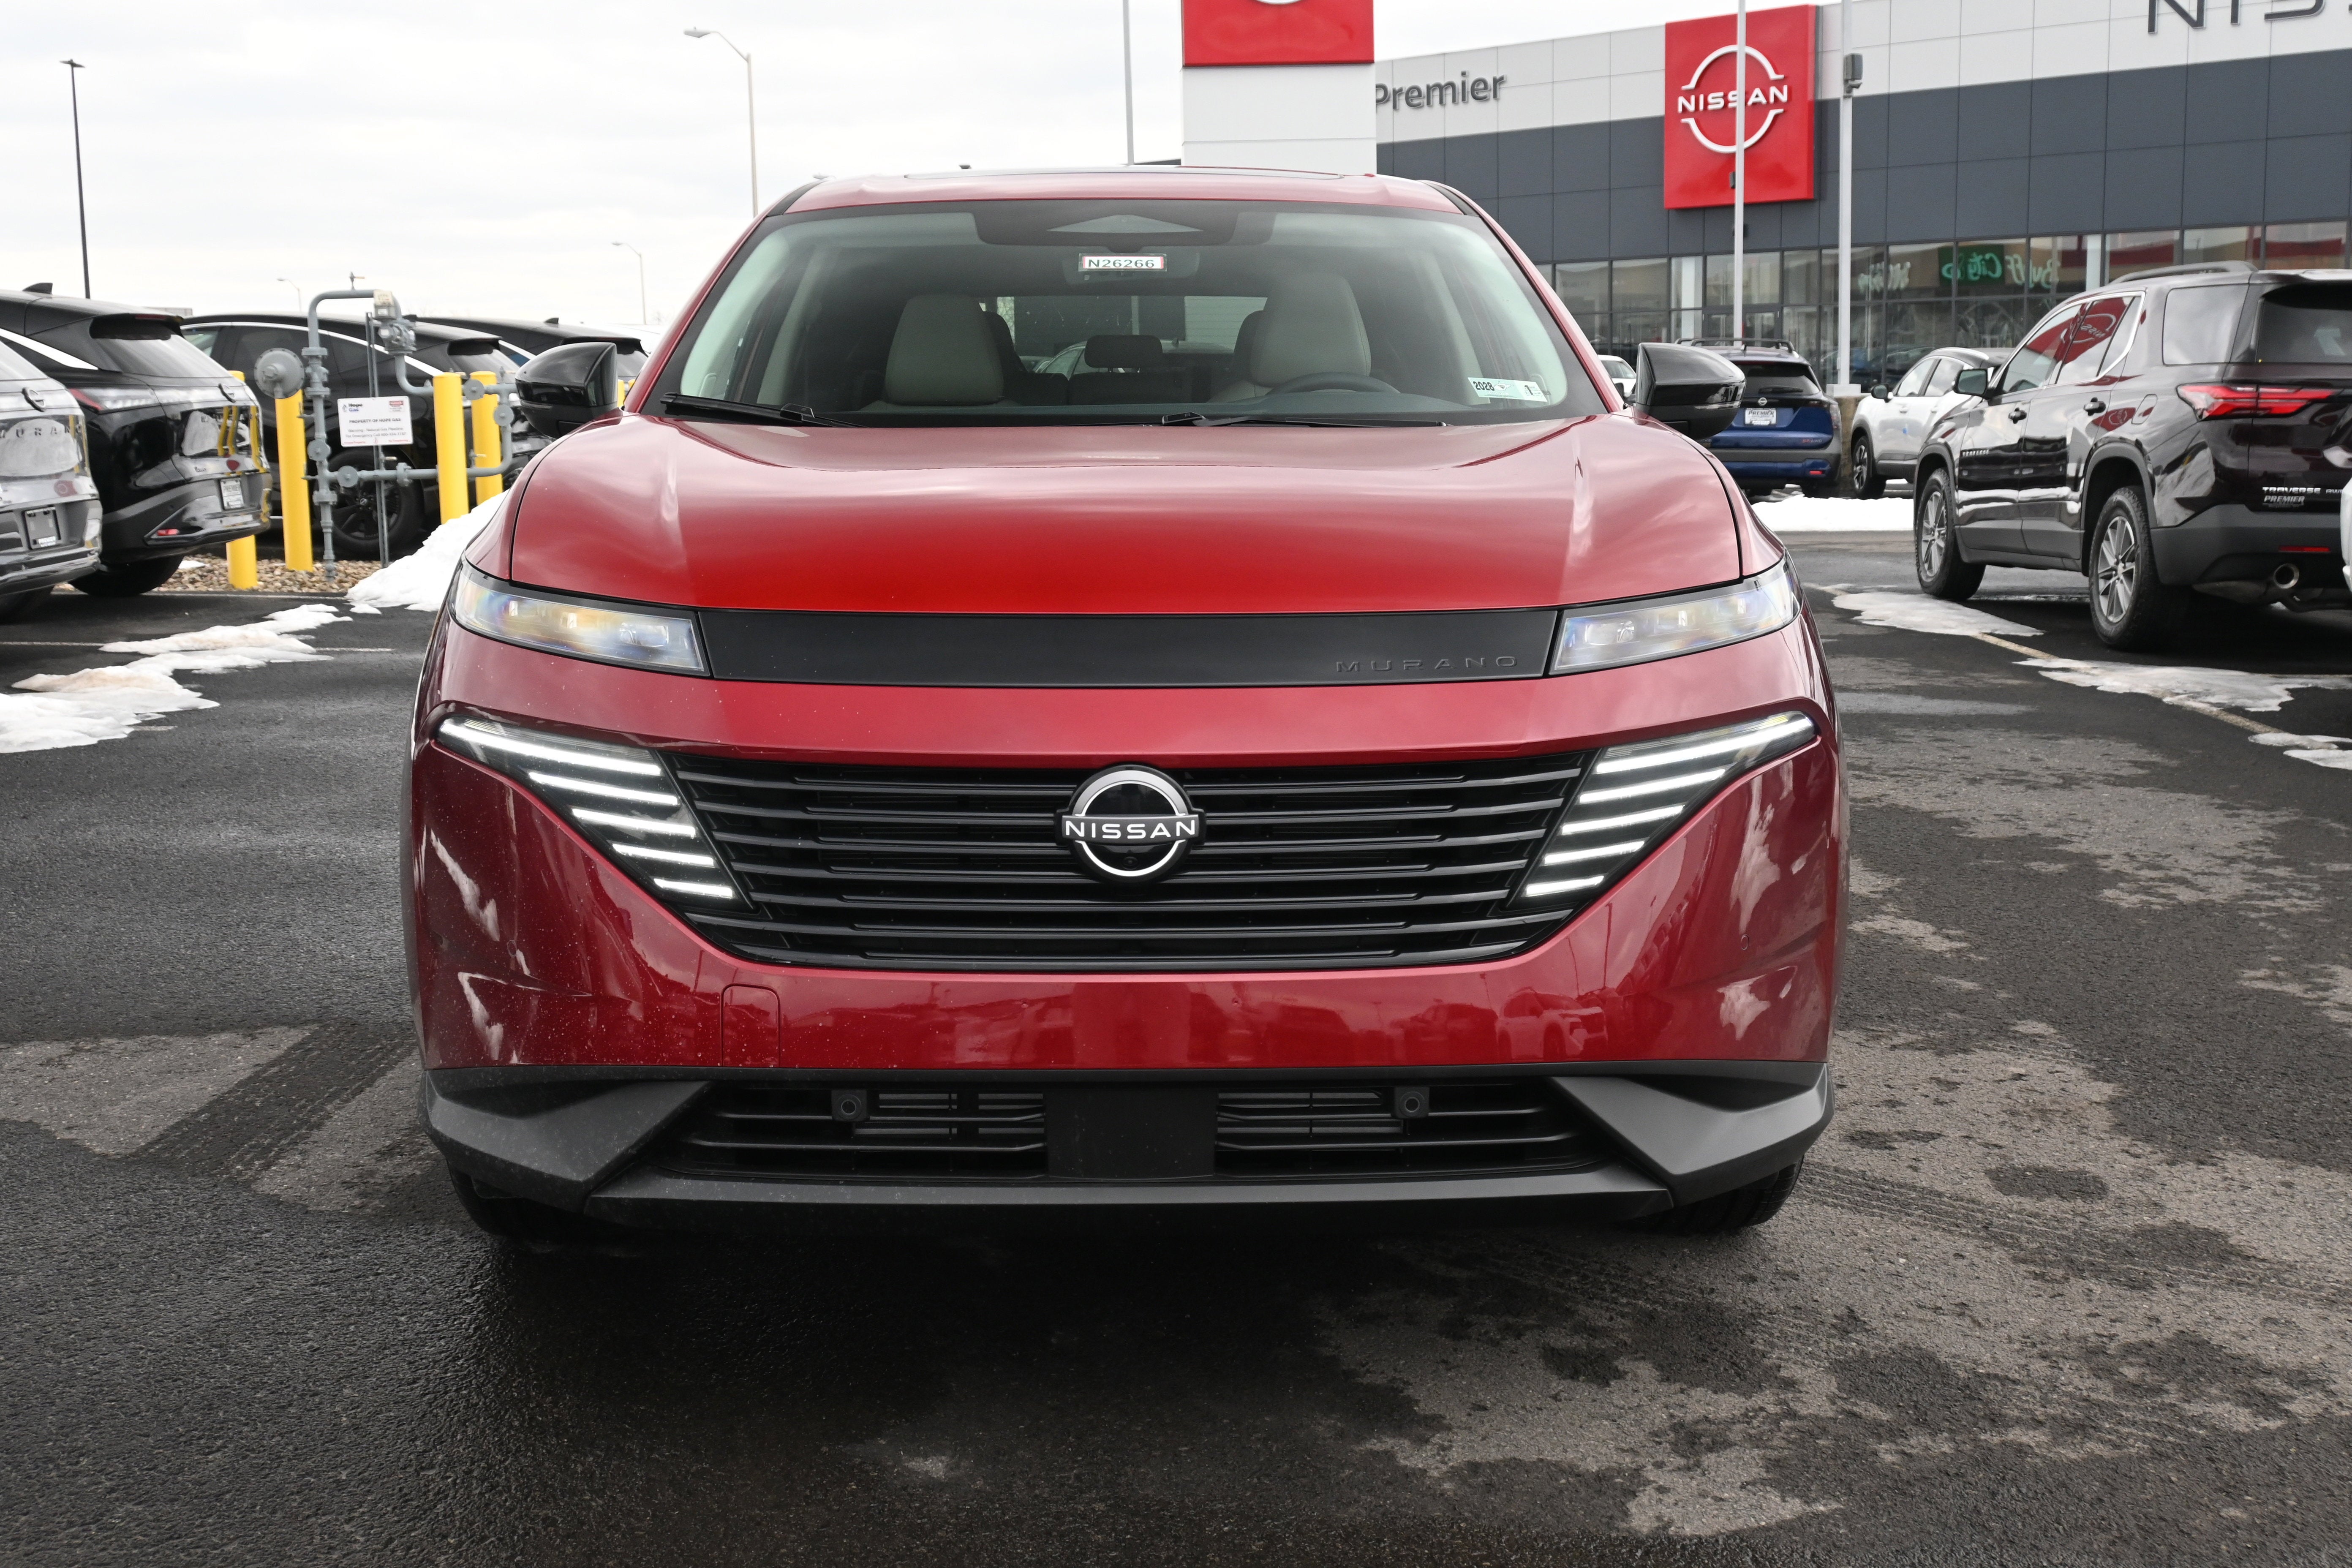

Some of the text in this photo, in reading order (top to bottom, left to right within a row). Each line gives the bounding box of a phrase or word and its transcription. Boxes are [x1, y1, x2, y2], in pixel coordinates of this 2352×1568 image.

[1677, 84, 1788, 113] NISSAN
[1089, 259, 1154, 267] N26266
[1473, 381, 1495, 391] 2028
[1336, 656, 1518, 672] MURANO
[1065, 819, 1195, 839] NISSAN
